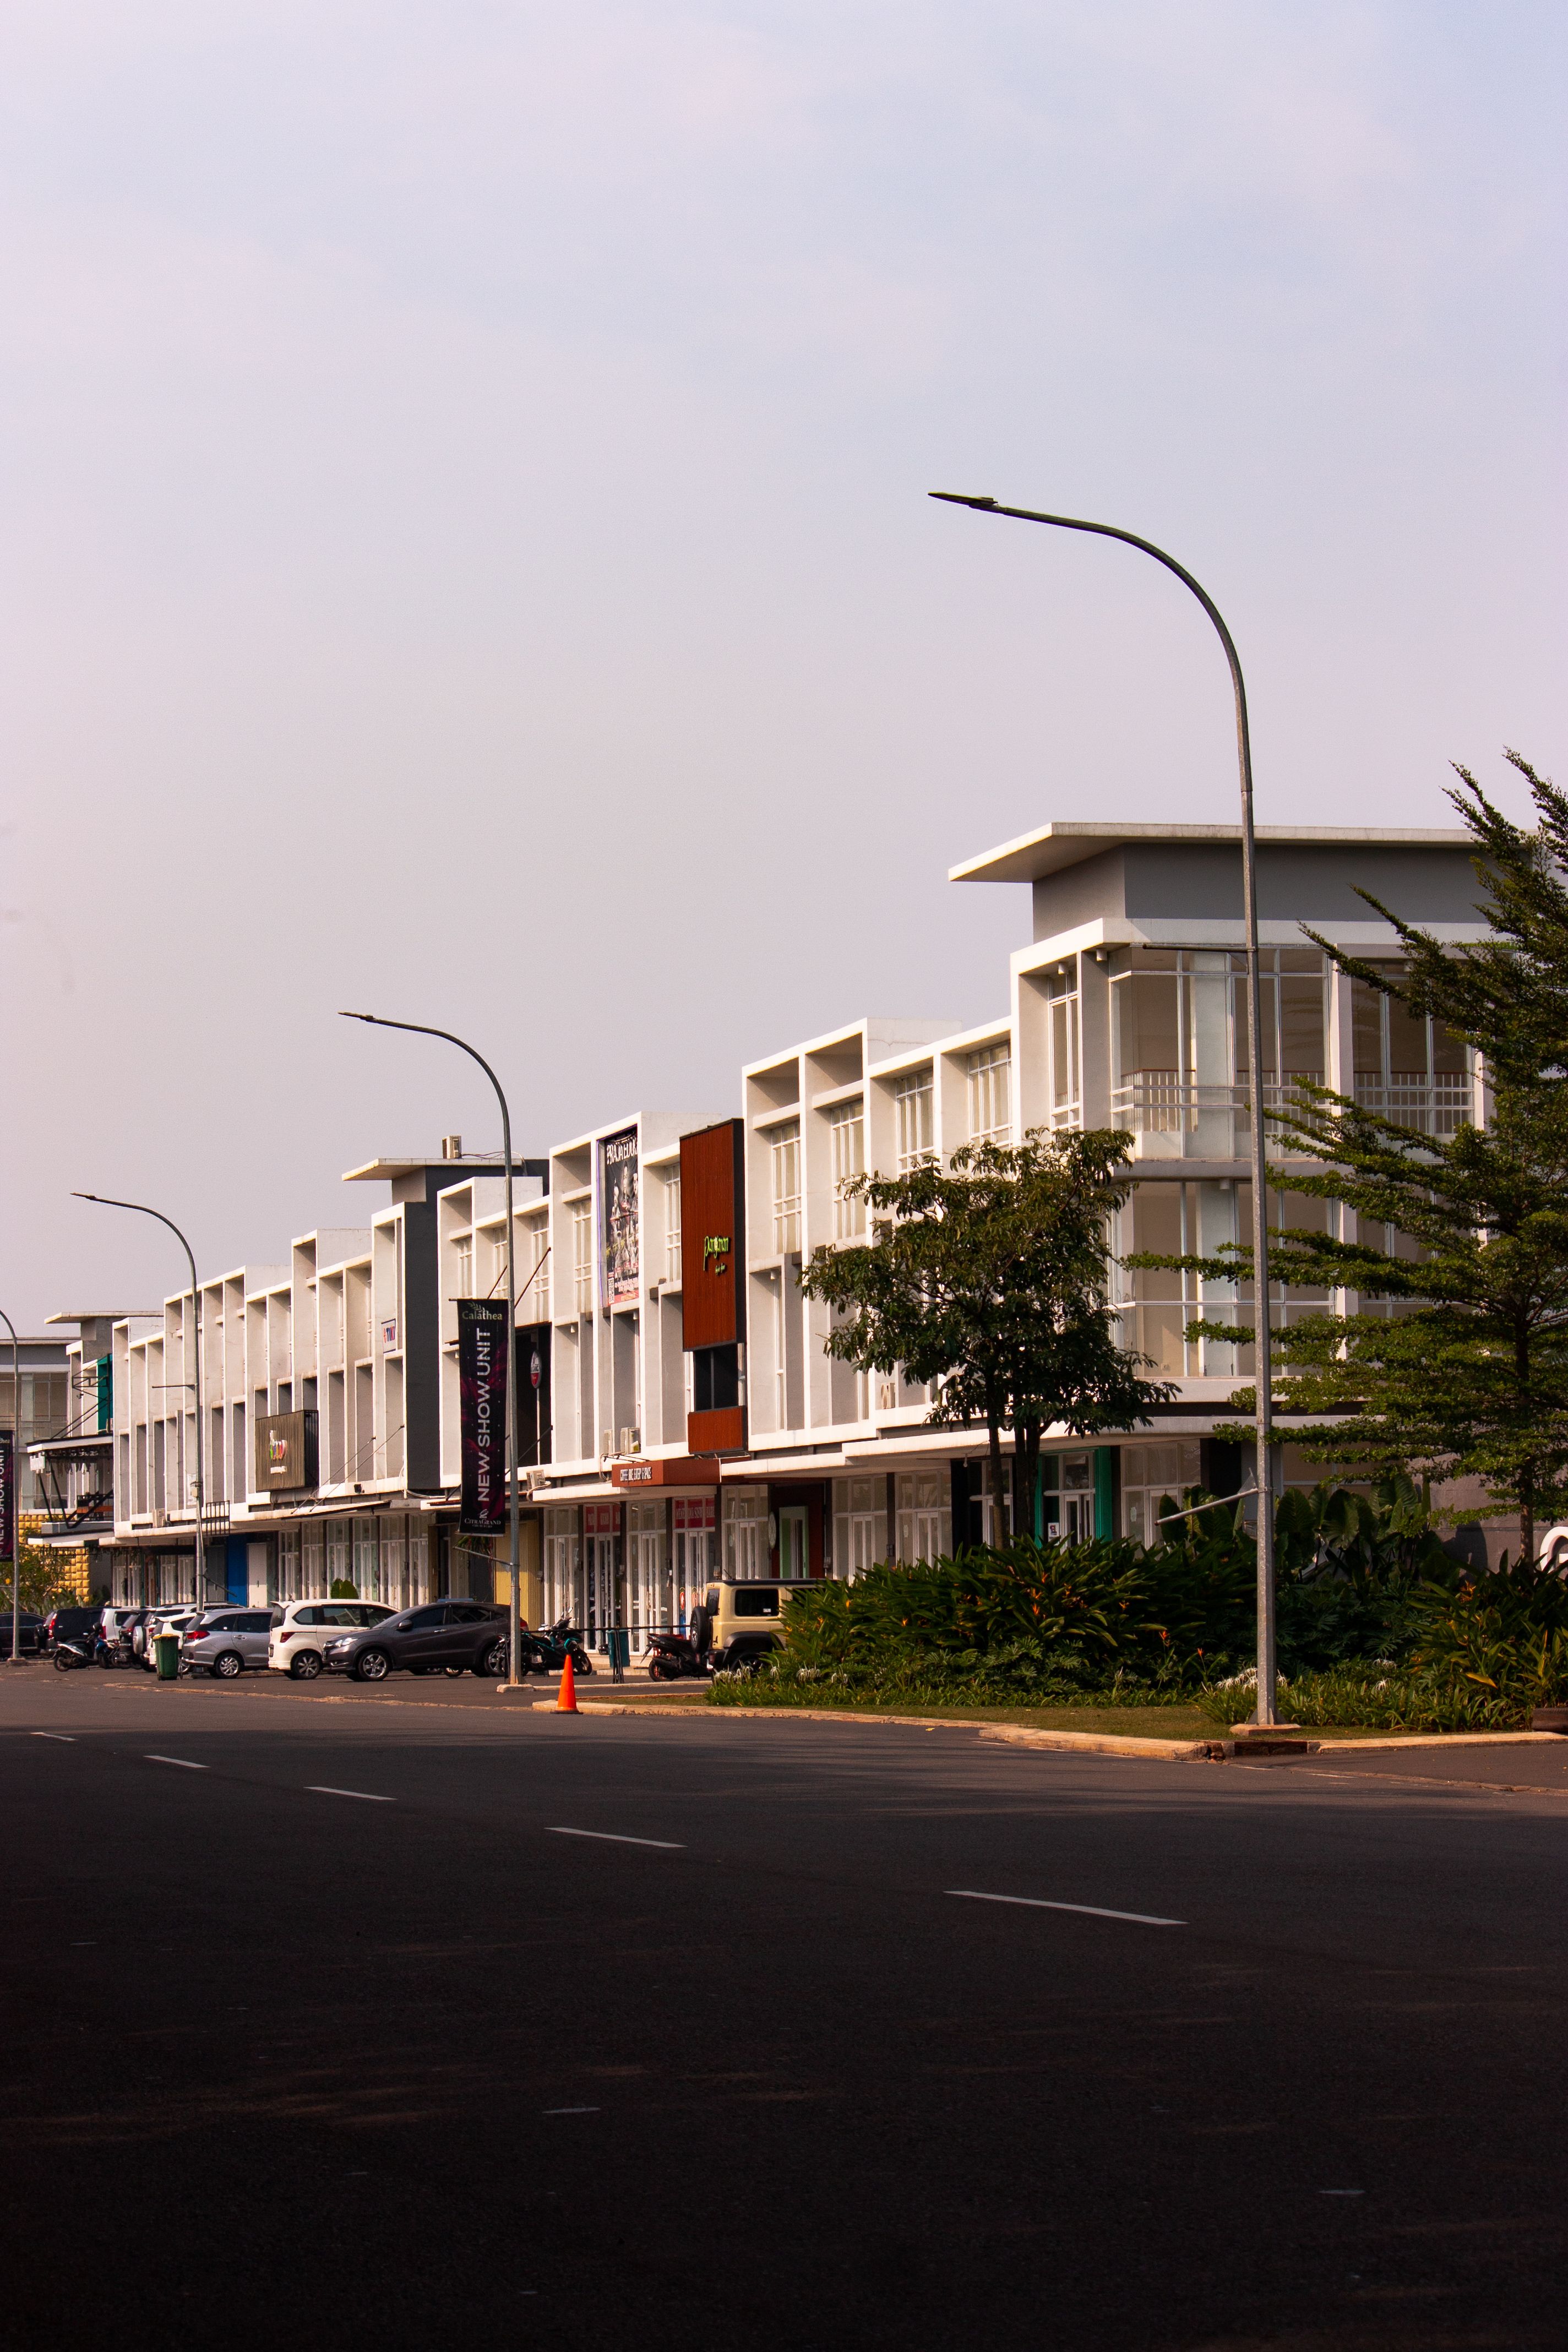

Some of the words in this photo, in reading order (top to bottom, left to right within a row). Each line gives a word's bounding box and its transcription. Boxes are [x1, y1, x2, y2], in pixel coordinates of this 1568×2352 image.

[462, 1310, 502, 1320] Calathea
[477, 1327, 491, 1376] UNIT
[477, 1381, 490, 1447] SHOW
[477, 1452, 490, 1501] NEW
